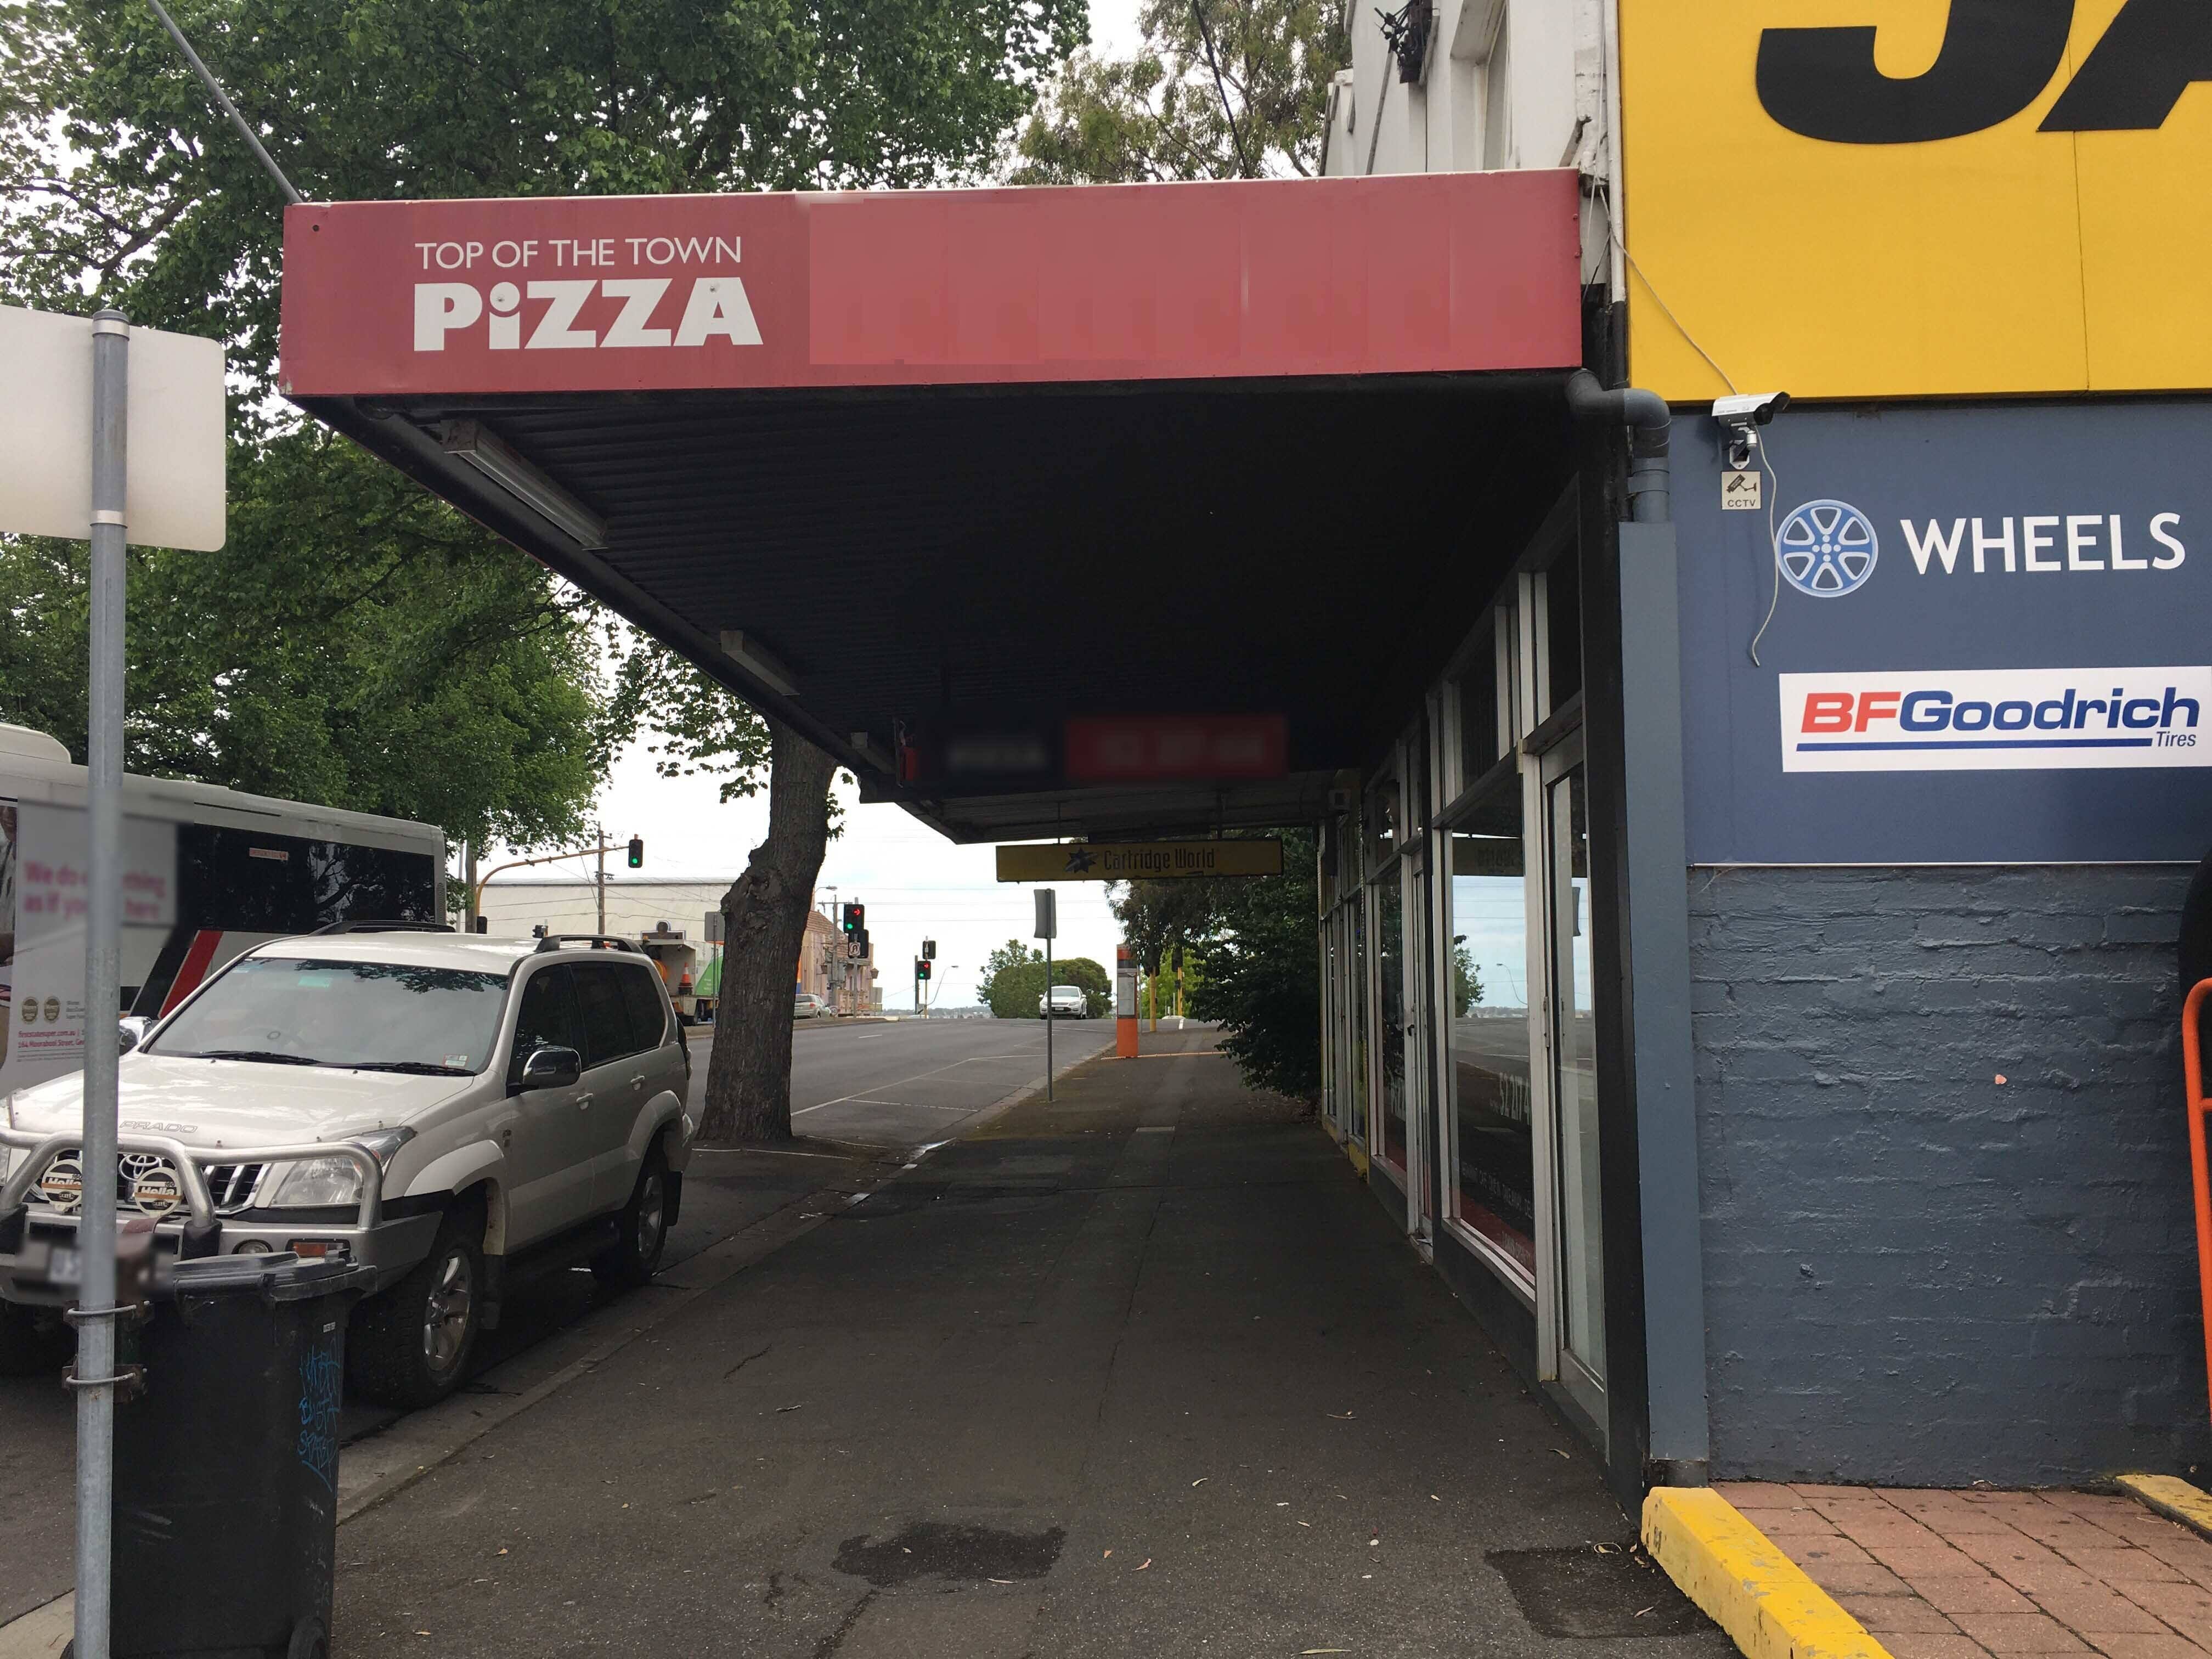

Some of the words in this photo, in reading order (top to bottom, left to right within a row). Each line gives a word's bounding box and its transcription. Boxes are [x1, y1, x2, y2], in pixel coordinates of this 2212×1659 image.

[415, 241, 483, 269] TOP
[492, 240, 538, 268] OF
[548, 239, 615, 267] THE
[625, 236, 741, 265] TOWN
[1727, 499, 1756, 507] CCTV
[1900, 512, 2186, 575] WHEELS
[1801, 687, 2200, 733] BFGoodrich
[2155, 731, 2197, 748] Tires
[1104, 848, 1171, 872] Cartridge
[1175, 848, 1215, 869] World
[119, 1120, 198, 1133] PRADO
[141, 1186, 175, 1195] Hella
